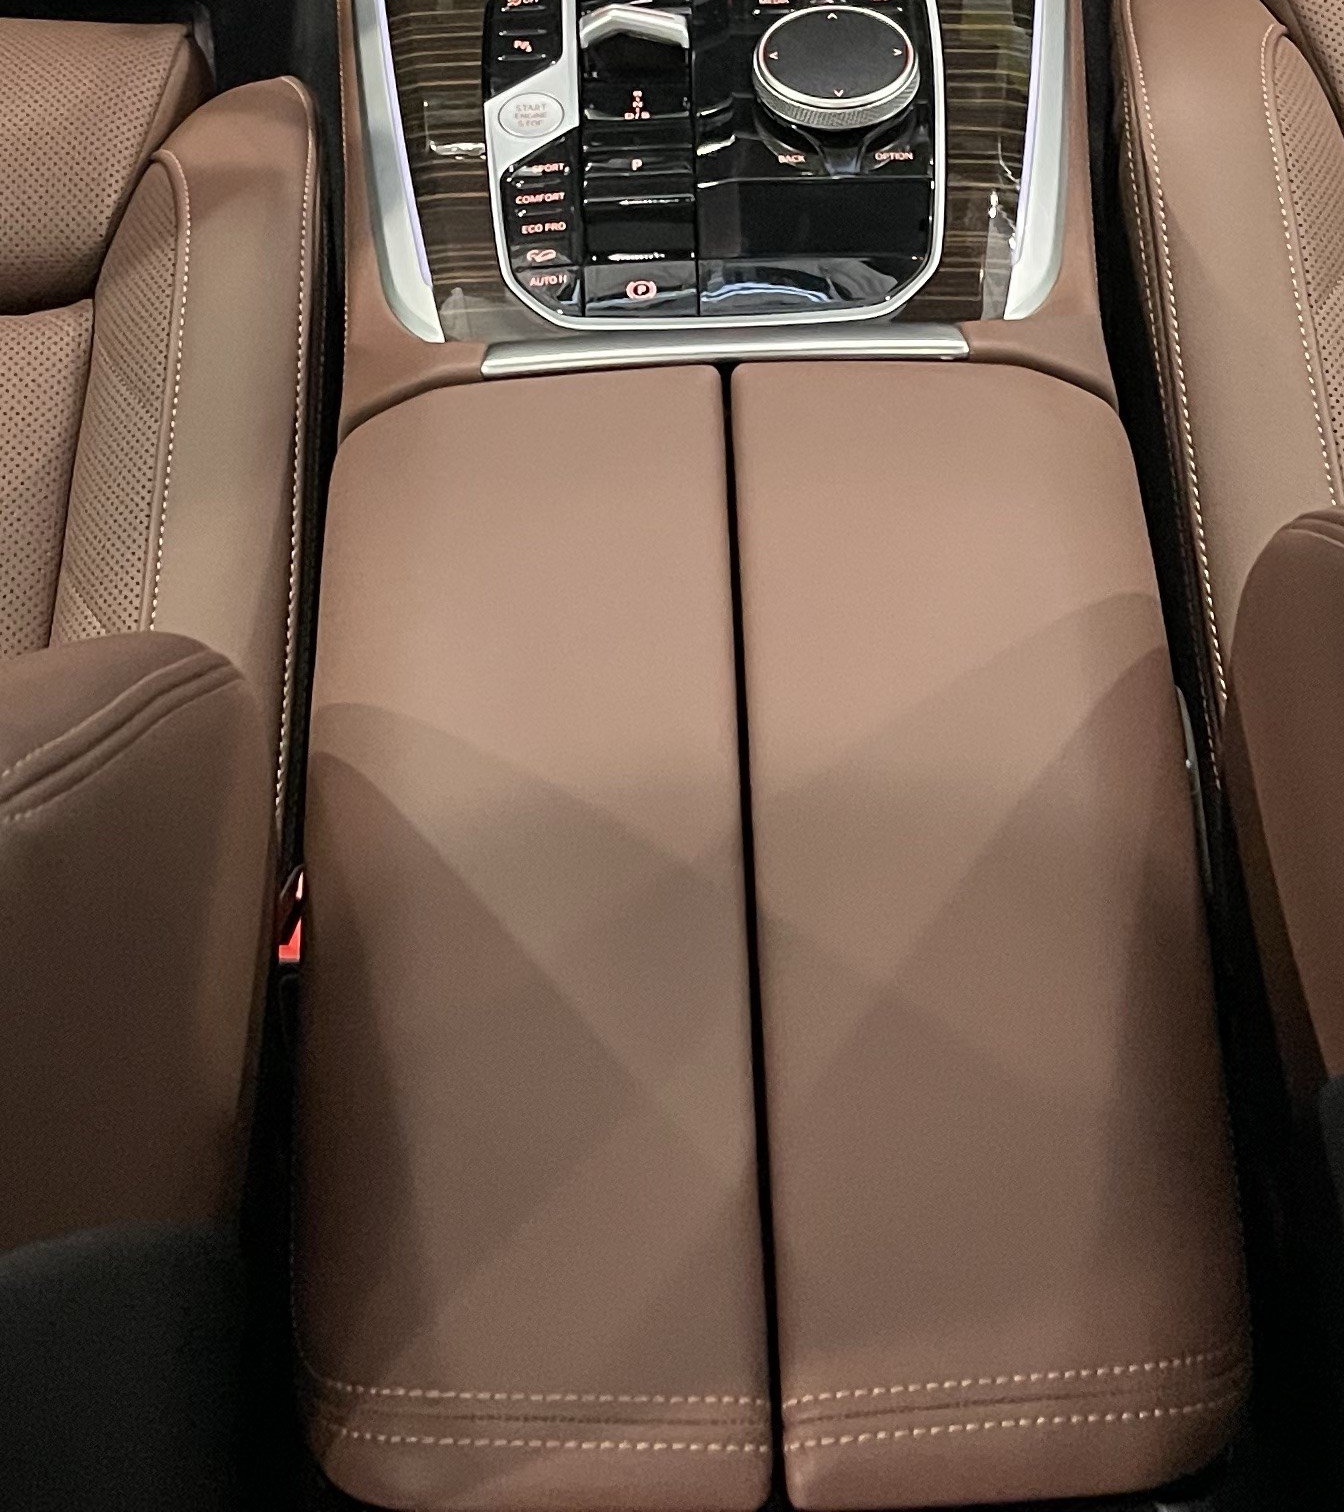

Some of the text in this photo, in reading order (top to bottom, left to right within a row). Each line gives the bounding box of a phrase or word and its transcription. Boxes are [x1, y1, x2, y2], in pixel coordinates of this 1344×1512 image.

[516, 104, 546, 112] START
[778, 155, 806, 163] BACK
[875, 152, 913, 160] OPTION
[532, 163, 565, 174] SPORT
[631, 159, 643, 171] P
[515, 192, 565, 204] COMFORT
[521, 222, 566, 234] ECO PRO
[530, 275, 556, 286] AUTO
